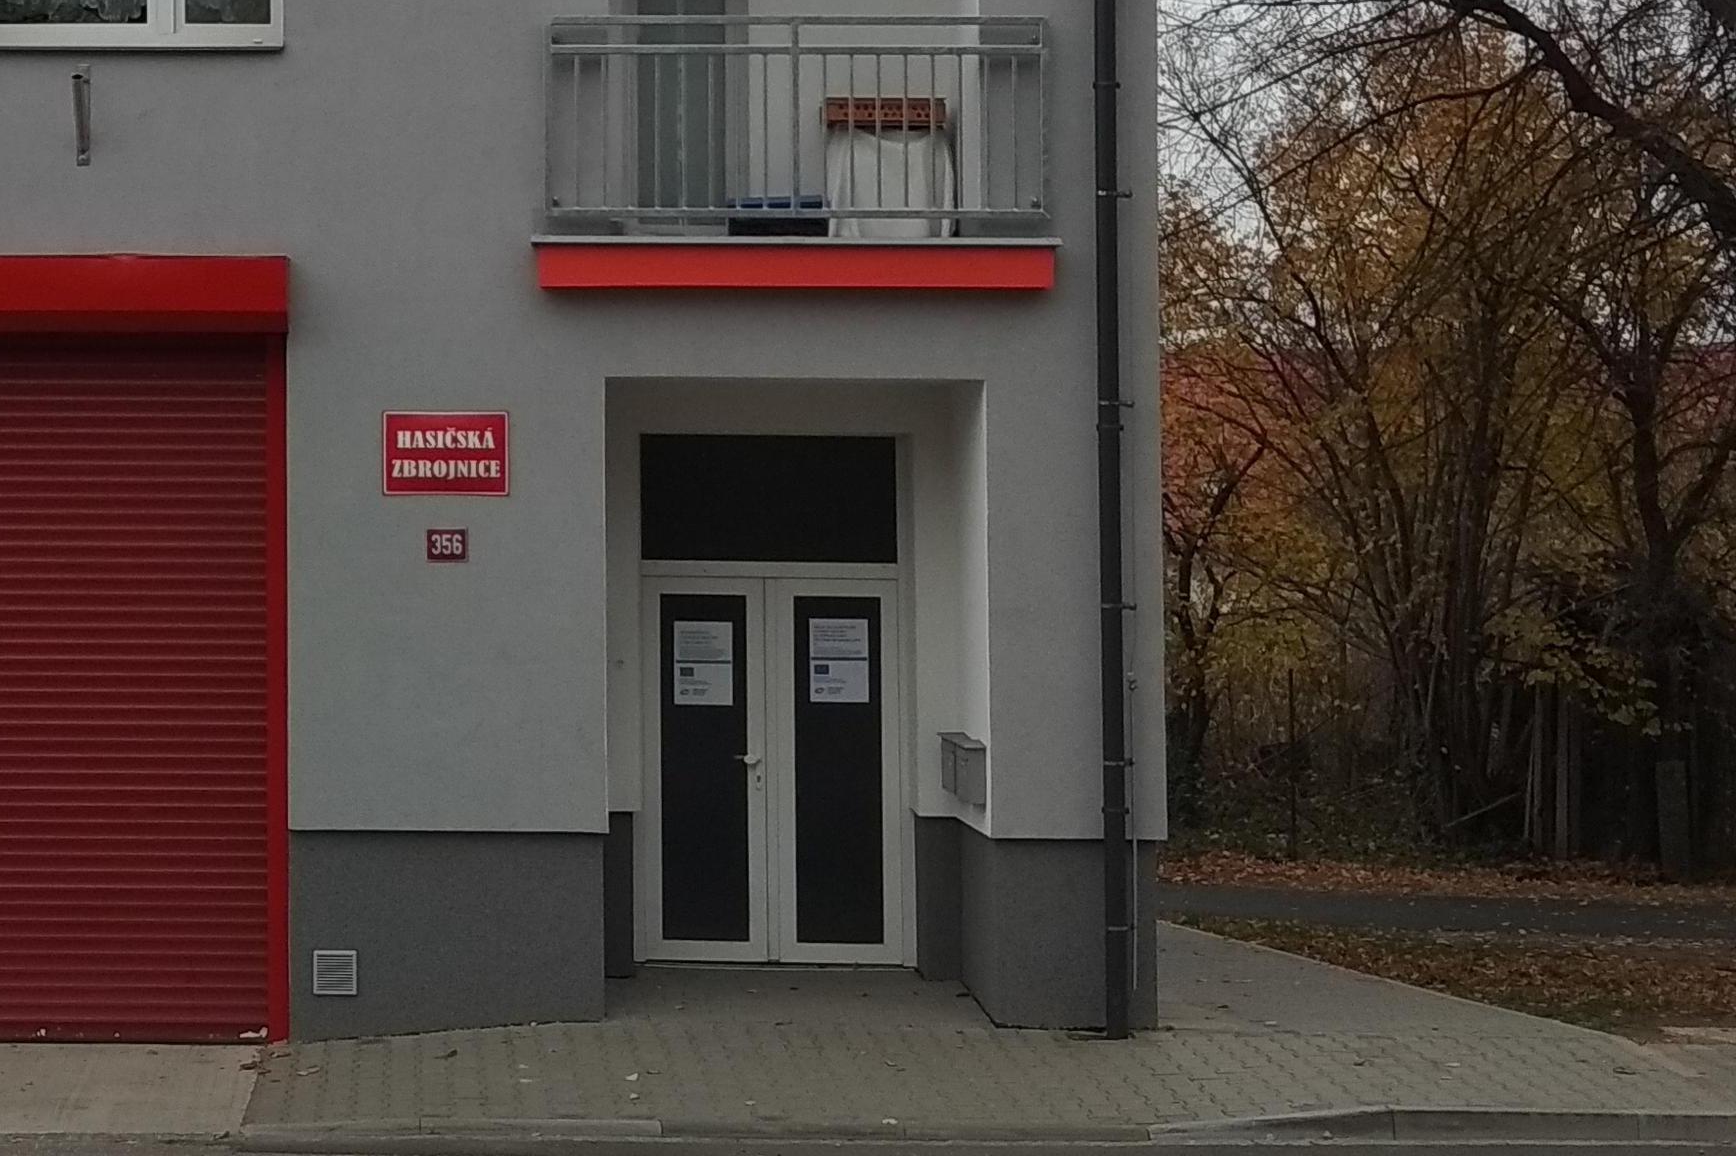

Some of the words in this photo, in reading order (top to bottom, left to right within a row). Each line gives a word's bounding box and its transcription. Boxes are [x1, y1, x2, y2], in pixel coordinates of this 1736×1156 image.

[396, 427, 495, 449] HASIČSKÁ
[392, 459, 501, 480] ZBROJNICE
[431, 534, 463, 555] 356
